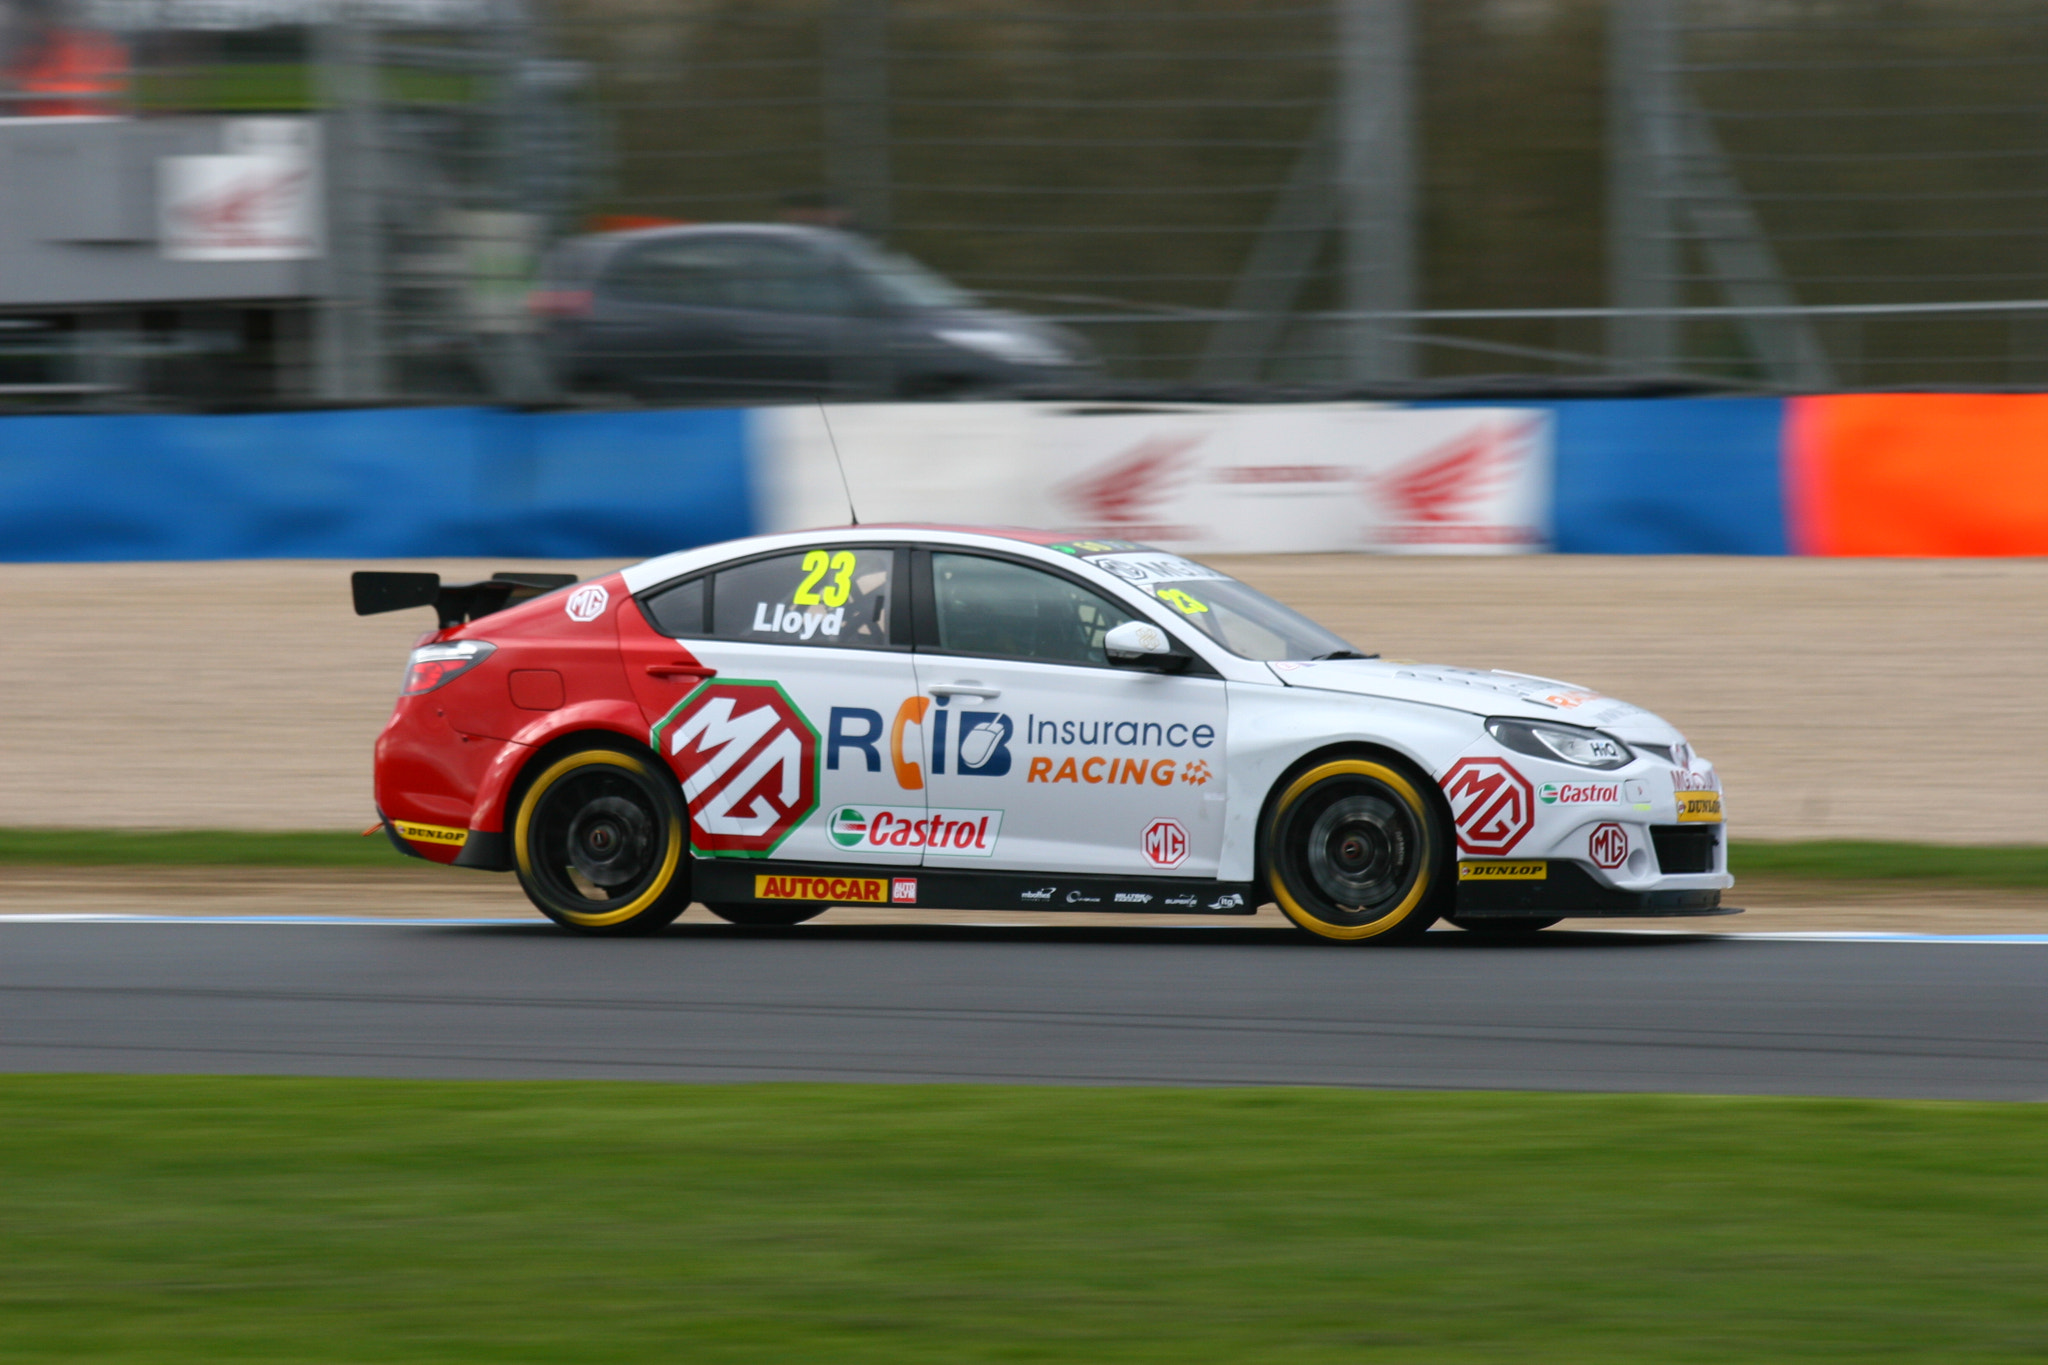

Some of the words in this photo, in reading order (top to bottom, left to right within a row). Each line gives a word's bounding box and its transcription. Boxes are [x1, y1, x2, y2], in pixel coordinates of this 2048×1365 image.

[793, 549, 856, 607] 23
[753, 602, 845, 640] Lloyd
[1027, 713, 1215, 748] Insurance
[671, 696, 802, 837] MG
[1027, 756, 1177, 786] RACING
[1450, 769, 1521, 841] MG
[1560, 784, 1618, 803] Castrol
[408, 827, 465, 841] DUNLOP
[868, 811, 991, 851] Castrol
[1146, 823, 1186, 864] MG
[1594, 828, 1624, 864] MG
[763, 877, 881, 900] AUTOCAR
[894, 882, 915, 891] AUTO
[1473, 865, 1544, 877] DUNLOP
